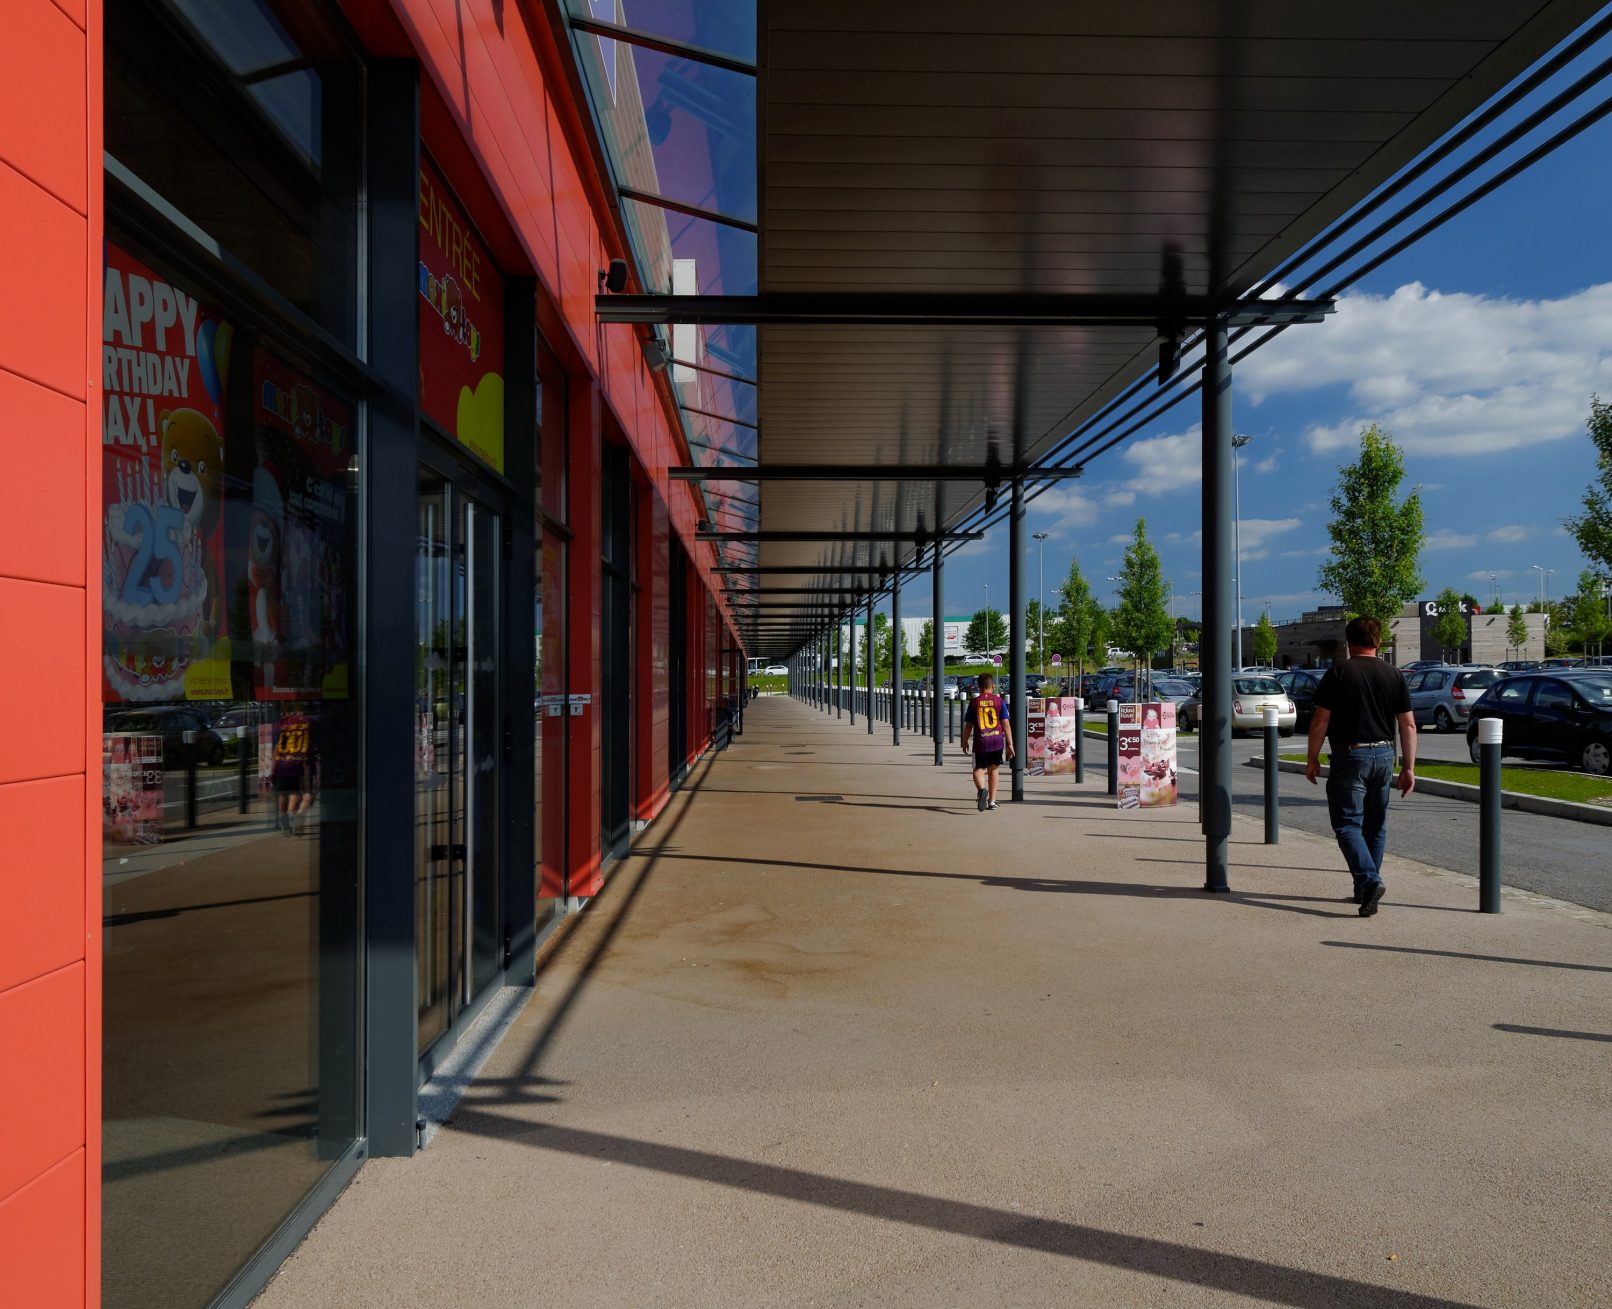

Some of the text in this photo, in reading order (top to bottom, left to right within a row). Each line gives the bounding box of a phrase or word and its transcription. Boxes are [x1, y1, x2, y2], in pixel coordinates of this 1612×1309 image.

[419, 170, 482, 303] ENTRÉE
[103, 394, 158, 447] AX!
[122, 502, 185, 606] 25
[1424, 601, 1468, 617] Quk
[978, 707, 998, 730] 10
